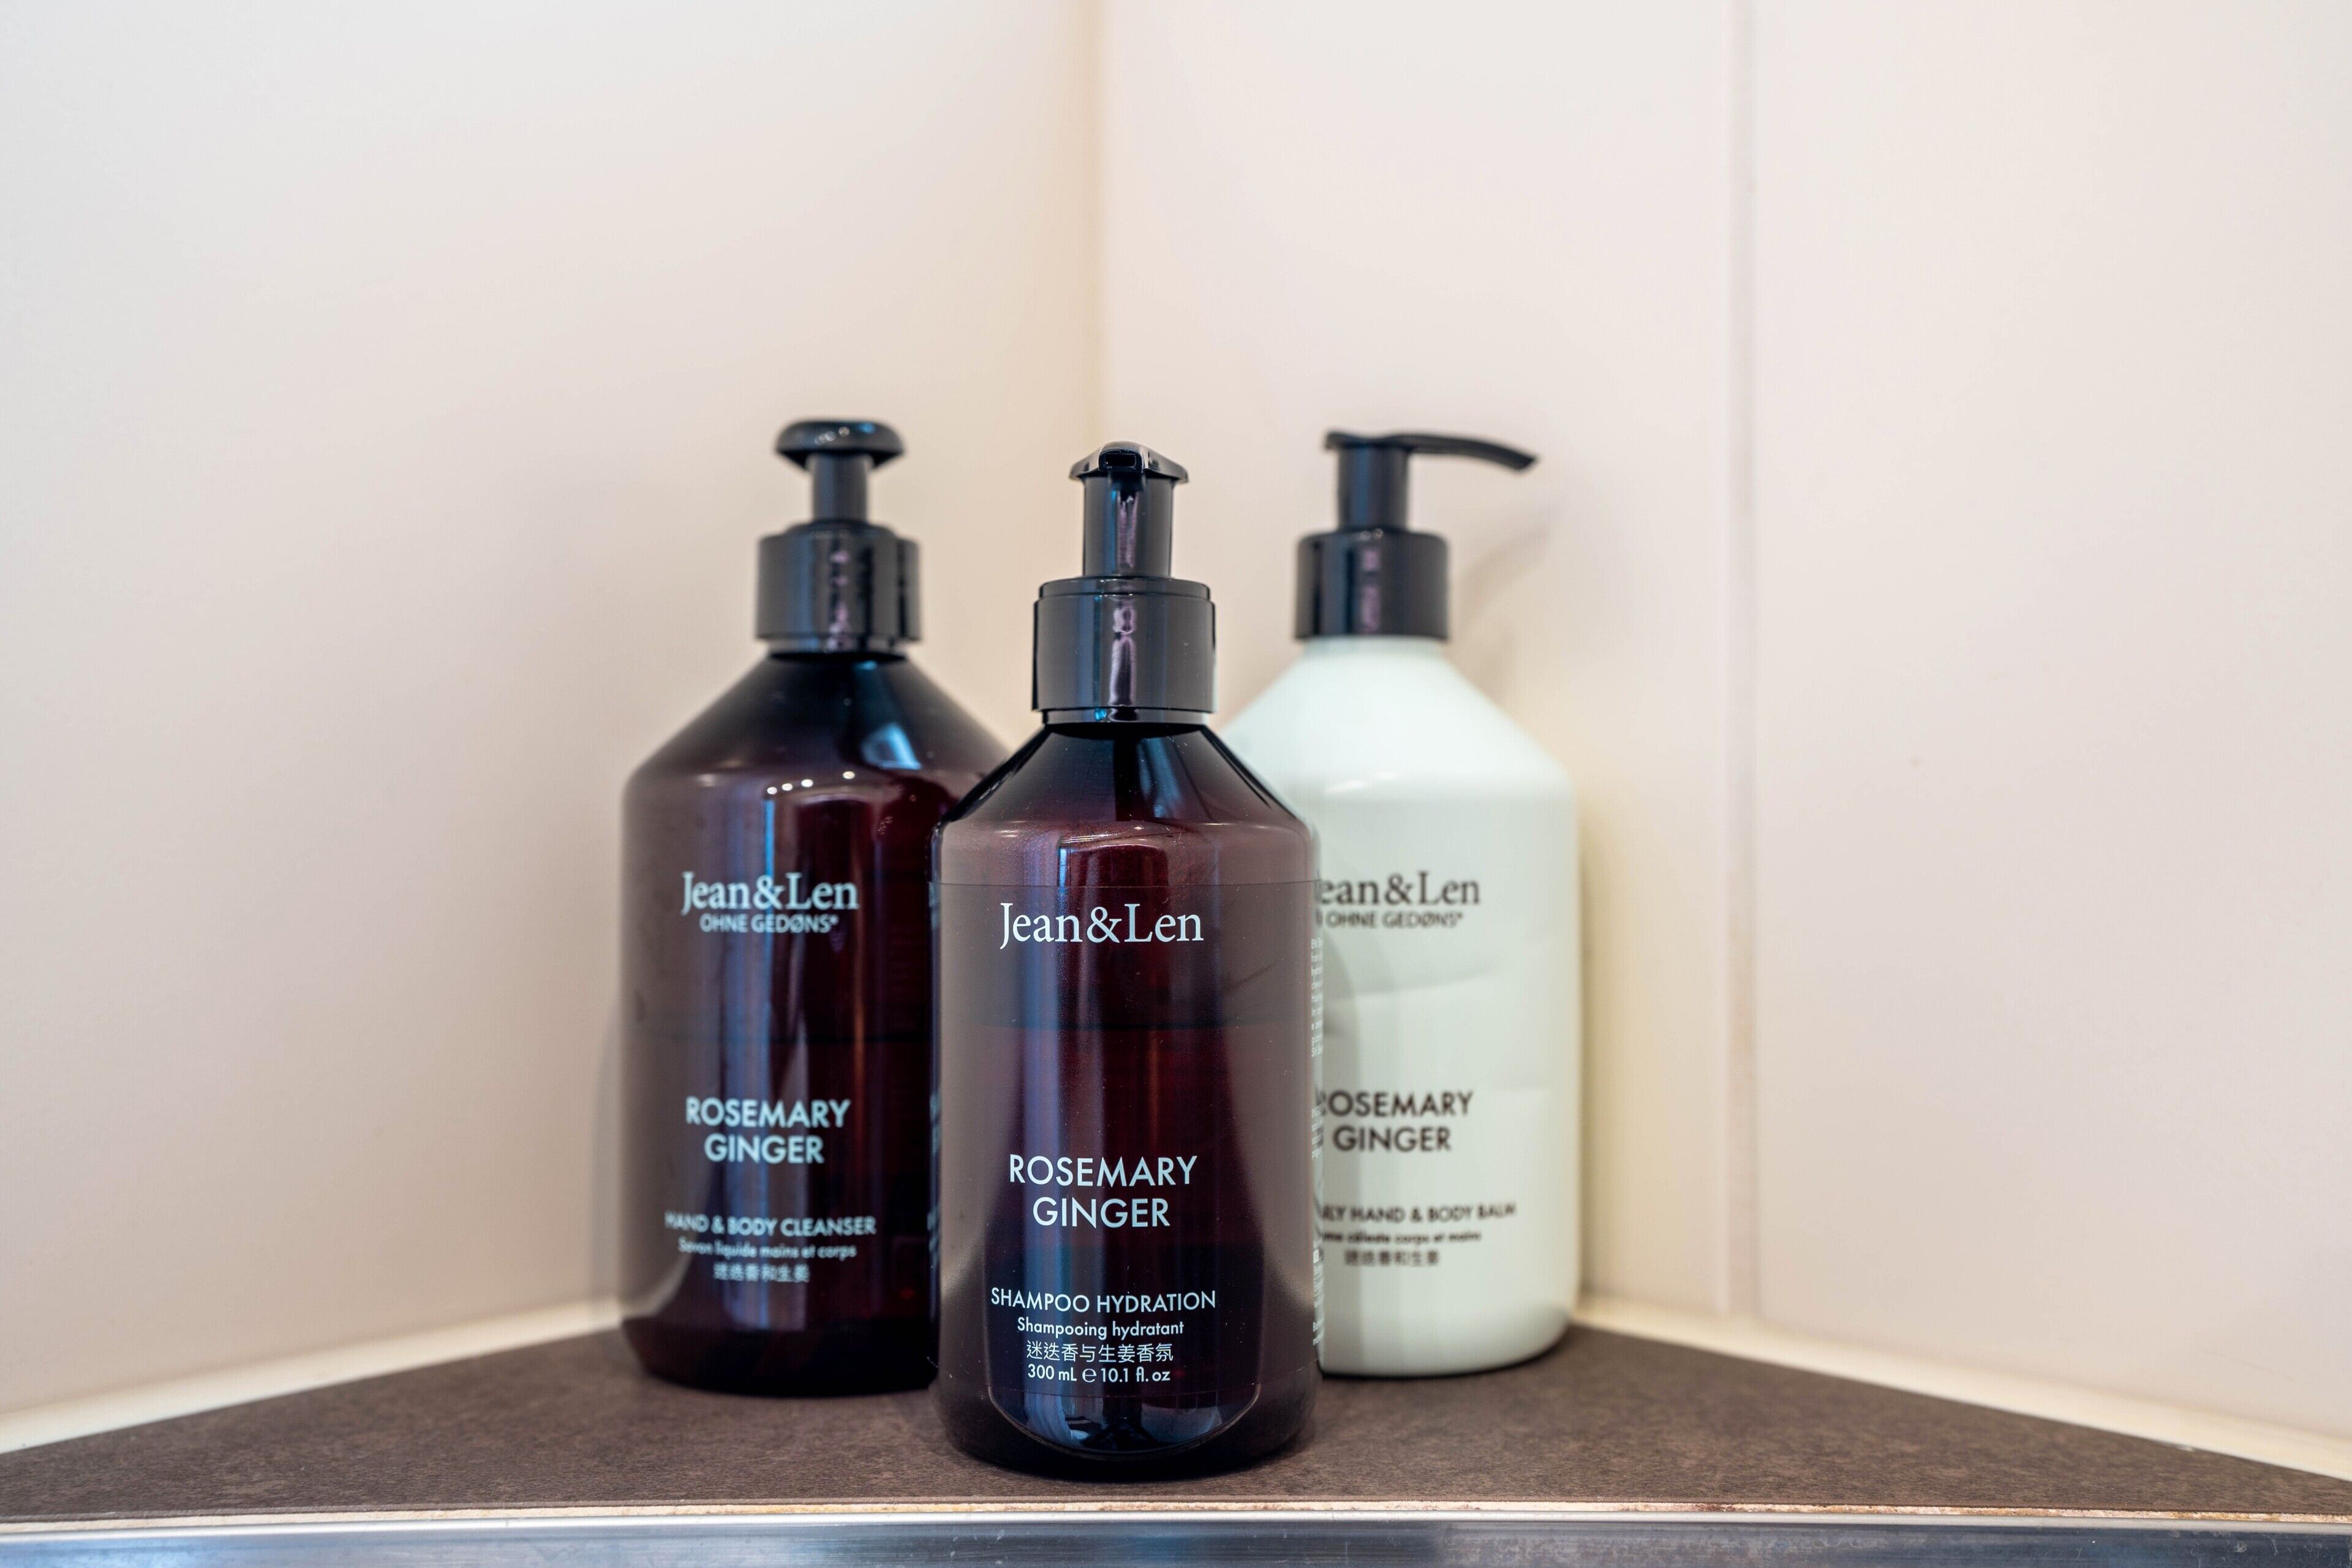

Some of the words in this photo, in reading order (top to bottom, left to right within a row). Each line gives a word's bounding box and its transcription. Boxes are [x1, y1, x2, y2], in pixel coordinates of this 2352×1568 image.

[680, 871, 859, 916] Jean&Len
[1320, 870, 1480, 905] ean&Len
[699, 913, 748, 932] OHNE
[1000, 903, 1204, 949] Jean&Len
[1325, 911, 1376, 928] OHNE
[687, 1097, 851, 1128] ROSEMARY
[704, 1133, 824, 1163] GINGER
[1332, 1125, 1450, 1153] GINGER
[1010, 1154, 1197, 1187] ROSEMARY
[665, 1211, 710, 1232] HAND
[711, 1216, 725, 1234] &
[728, 1216, 777, 1235] BODY
[780, 1216, 876, 1237] CLEANSER
[1033, 1197, 1170, 1228] GINGER
[1351, 1208, 1406, 1222] HAND
[1410, 1208, 1423, 1223] &
[1427, 1206, 1473, 1222] BODY
[1477, 1204, 1516, 1219] BALM
[678, 1237, 713, 1254] Savon
[714, 1239, 757, 1260] liquide
[760, 1243, 799, 1258] mains
[801, 1245, 816, 1258] et
[817, 1245, 857, 1261] corps
[991, 1287, 1090, 1312] SHAMPOO
[1098, 1291, 1215, 1313] HYDRATION
[1017, 1317, 1107, 1340] Shampooing
[1113, 1321, 1184, 1340] hydratant
[1027, 1340, 1173, 1363] 迷迭香与生姜香氛
[1028, 1363, 1054, 1379] 300
[1058, 1367, 1077, 1381] mL
[1101, 1368, 1128, 1382] 10.1
[1136, 1366, 1148, 1382] fl.
[1152, 1371, 1170, 1381] oz
